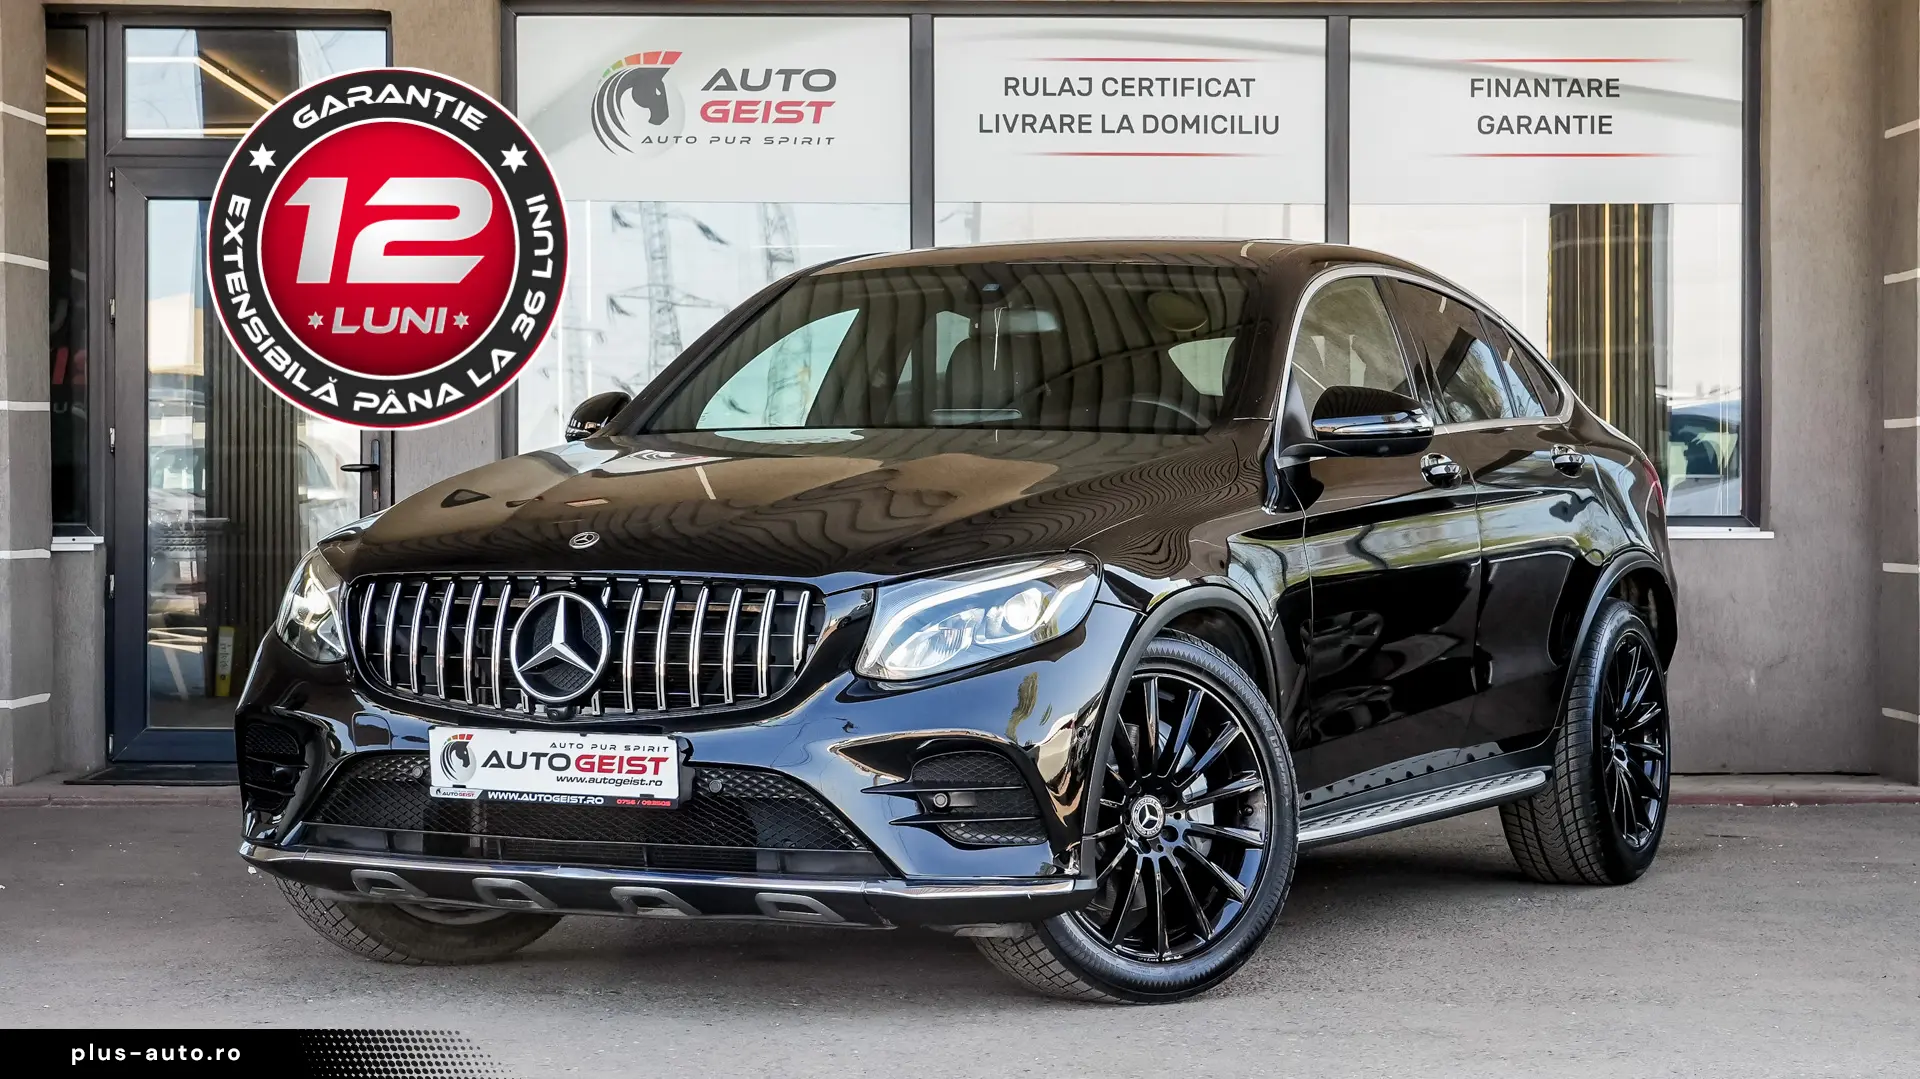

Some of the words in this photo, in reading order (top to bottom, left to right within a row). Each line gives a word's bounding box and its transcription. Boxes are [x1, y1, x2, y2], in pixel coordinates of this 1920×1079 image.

[700, 67, 837, 92] AUTO
[1003, 76, 1093, 97] RULAJ
[1101, 76, 1256, 98] CERTIFICAT
[1470, 78, 1620, 98] FINANTARE
[699, 99, 837, 124] GEIST
[978, 113, 1092, 134] LIVRARE
[1101, 113, 1135, 134] LA
[1142, 114, 1279, 135] DOMICILIU
[1477, 115, 1613, 135] GARANTIE
[641, 135, 697, 145] AUTO
[709, 135, 752, 145] PUR
[763, 136, 835, 146] SPIRIT
[549, 742, 584, 750] AUTO
[591, 743, 617, 751] PUR
[556, 775, 663, 787] www.autogeist.ro
[488, 791, 604, 805] WWW.AUTOGEIST.RO
